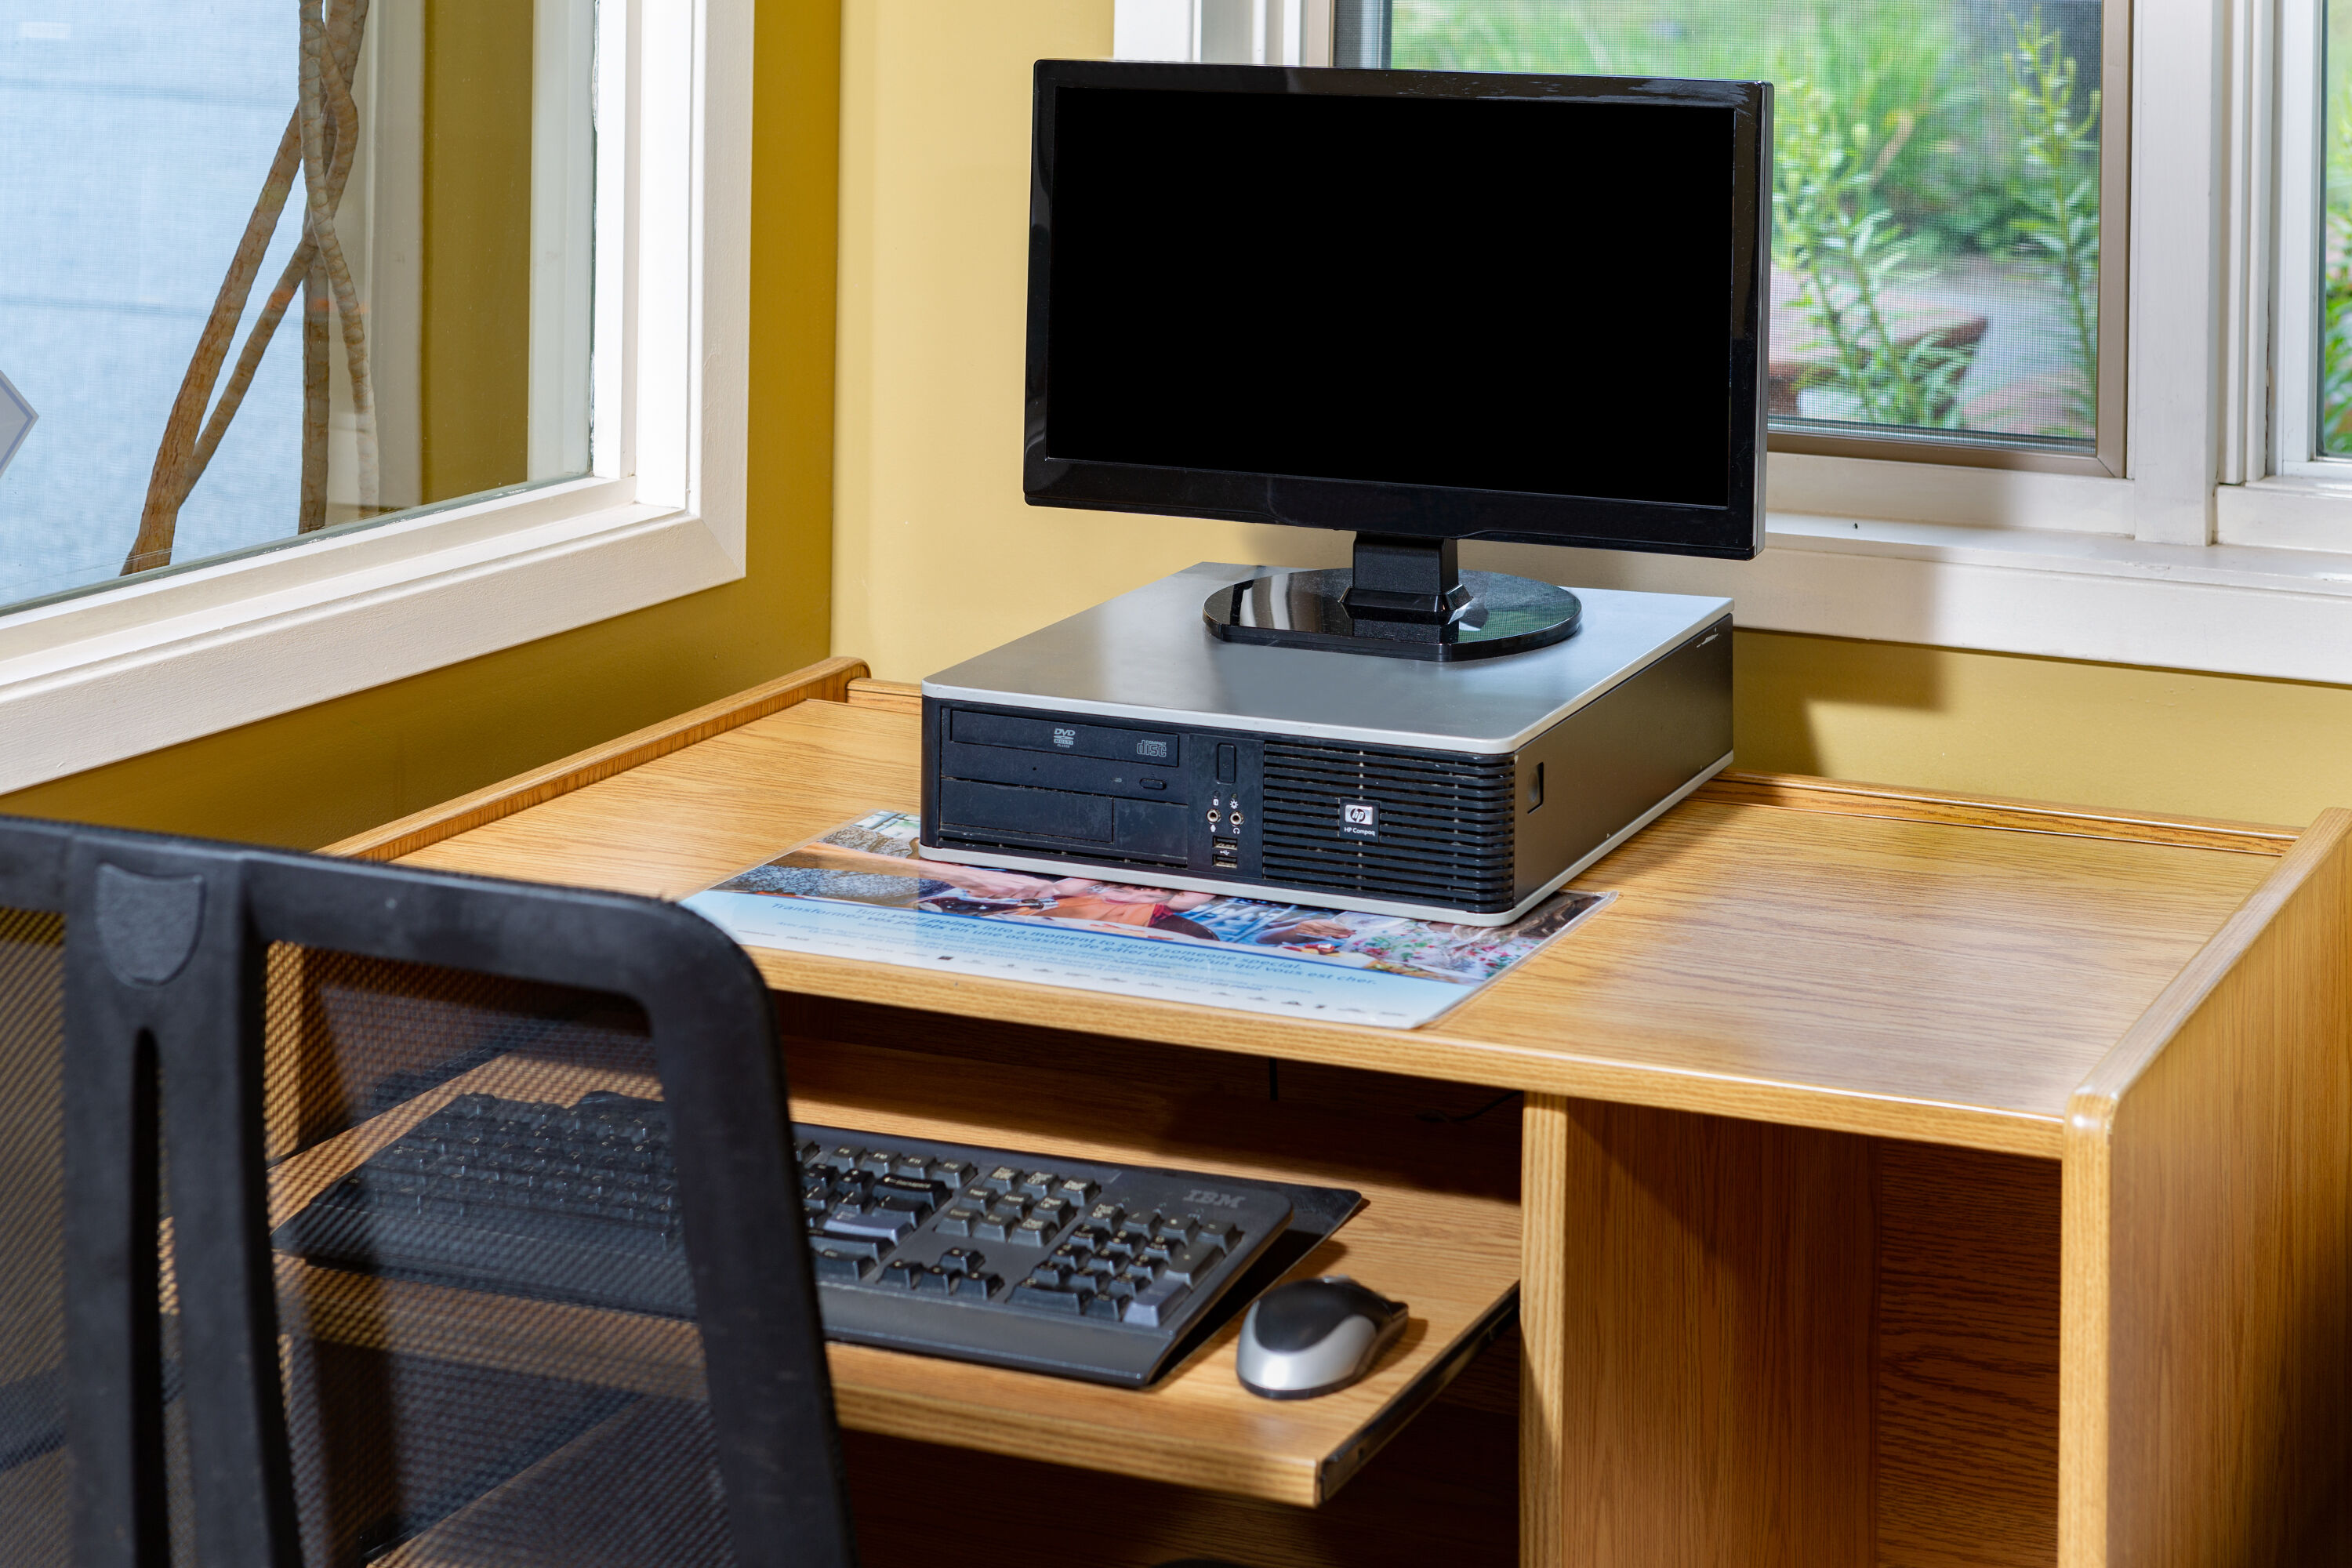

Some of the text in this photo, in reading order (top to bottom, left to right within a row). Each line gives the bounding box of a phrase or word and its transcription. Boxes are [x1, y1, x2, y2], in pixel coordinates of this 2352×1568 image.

[1054, 728, 1076, 737] DVD
[1137, 739, 1167, 757] disc
[1352, 827, 1375, 837] Compaq
[771, 903, 862, 919] Transformez
[866, 916, 892, 924] vos
[893, 917, 946, 931] points
[972, 929, 1003, 938] une
[1005, 934, 1075, 946] occasion
[1078, 941, 1096, 950] de
[1232, 962, 1262, 973] qui
[1264, 966, 1303, 977] vous
[1306, 972, 1335, 981] est
[892, 914, 928, 926] your
[928, 919, 978, 929] points
[982, 923, 1014, 934] into
[1030, 931, 1096, 944] moment
[1099, 939, 1115, 948] to
[1118, 941, 1160, 953] spoil
[1163, 947, 1237, 962] someone
[1241, 957, 1302, 970] special.
[1182, 1189, 1247, 1209] IBM
